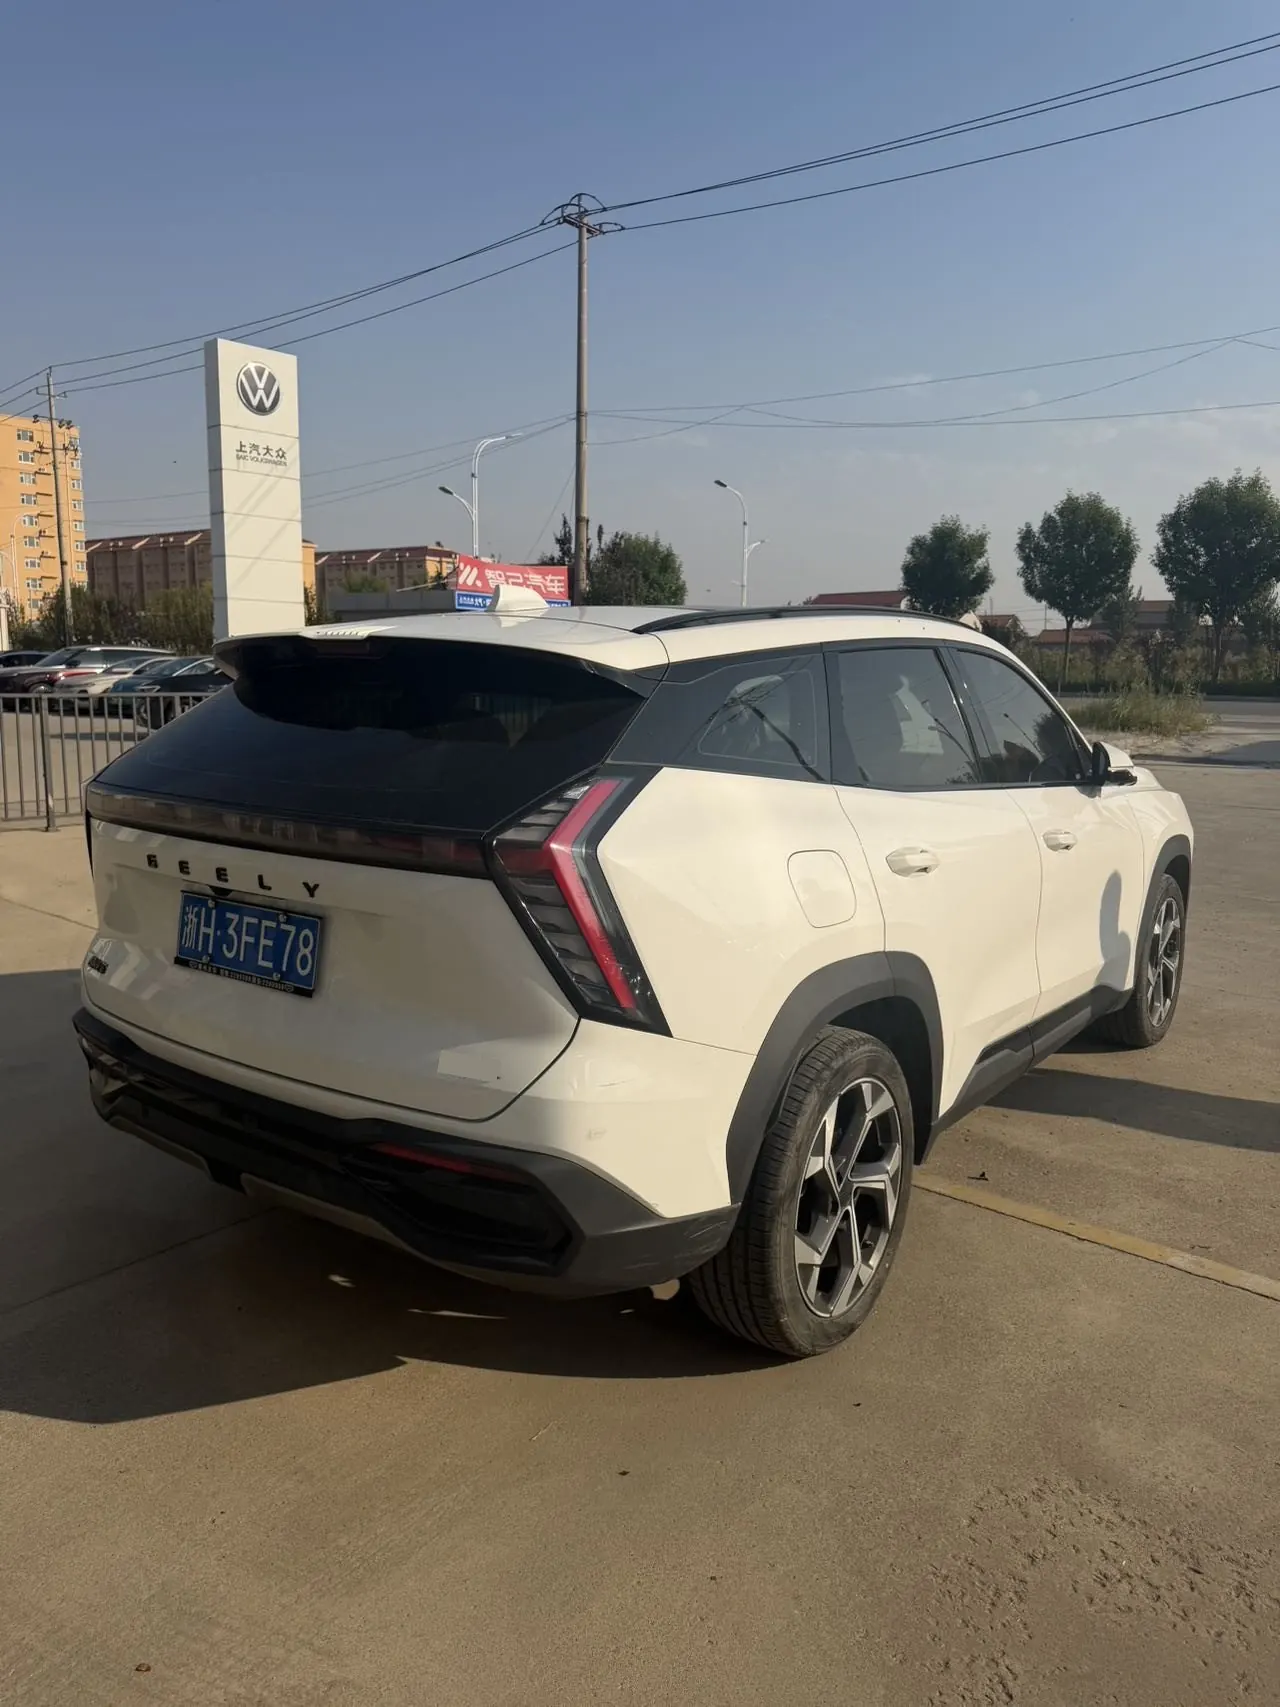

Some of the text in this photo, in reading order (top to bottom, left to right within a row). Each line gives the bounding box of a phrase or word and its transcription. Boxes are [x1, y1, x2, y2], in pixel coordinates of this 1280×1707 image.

[235, 441, 287, 460] 上汽大众
[146, 854, 319, 898] GEELY
